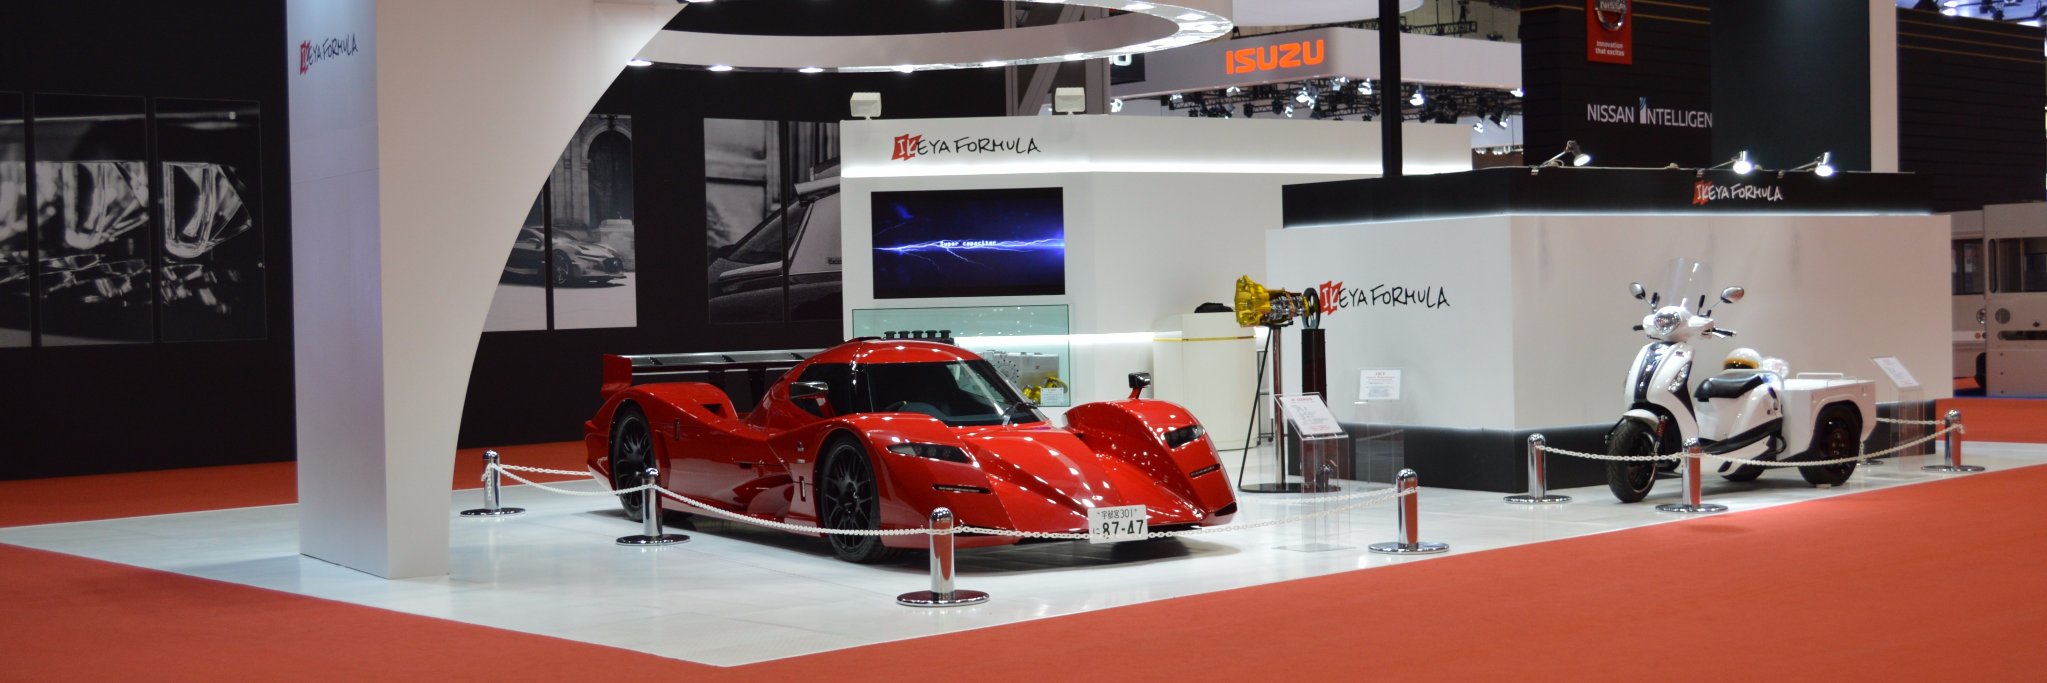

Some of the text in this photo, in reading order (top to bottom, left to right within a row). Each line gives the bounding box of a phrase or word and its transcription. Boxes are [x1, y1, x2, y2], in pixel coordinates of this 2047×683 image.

[323, 33, 359, 61] FORMULA
[1226, 40, 1325, 75] ISUZU
[1607, 49, 1625, 57] excites
[1587, 103, 1634, 123] NISSAN
[893, 134, 1041, 160] IKEYA FORMULA
[1694, 182, 1784, 204] IKEYA FORMULA
[940, 240, 960, 248] Super
[1320, 281, 1450, 313] IKEYA FORMULA
